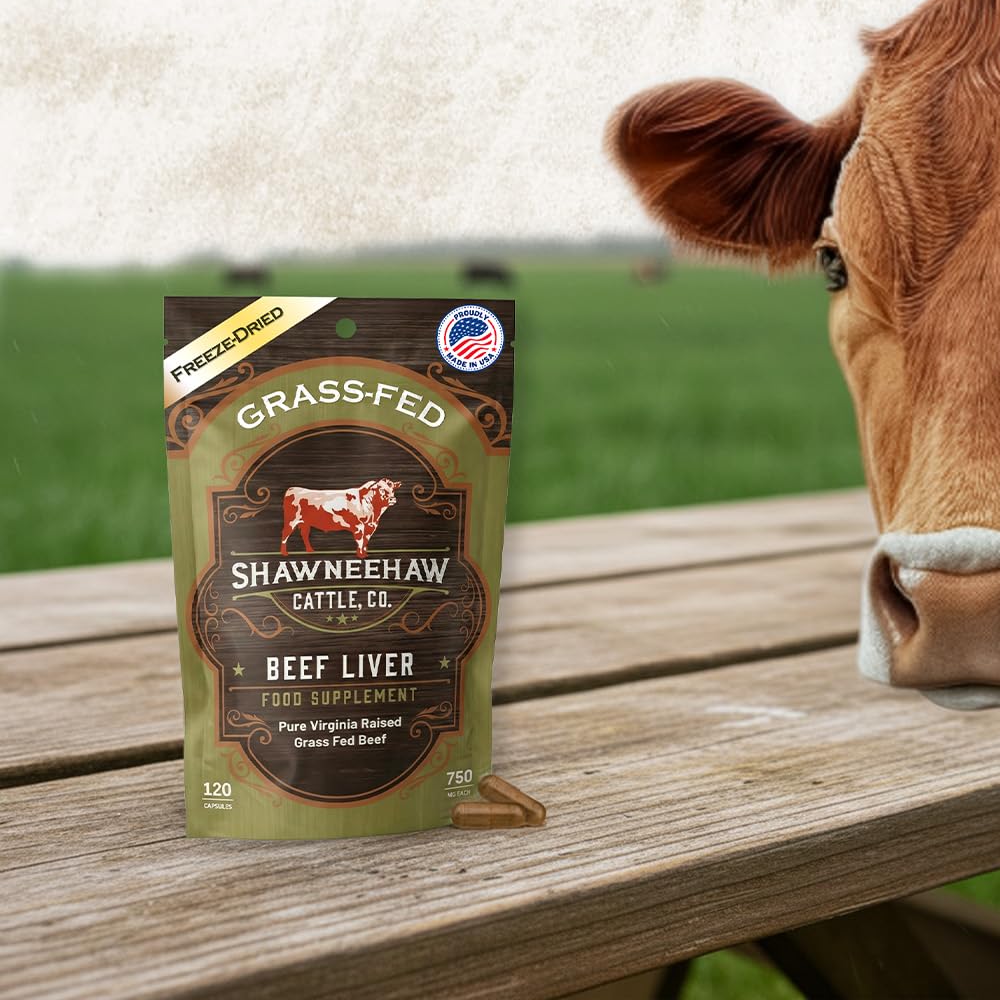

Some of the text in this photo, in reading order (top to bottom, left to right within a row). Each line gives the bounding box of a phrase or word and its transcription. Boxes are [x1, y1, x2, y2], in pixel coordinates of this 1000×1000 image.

[453, 310, 489, 321] PROUDLY
[446, 352, 468, 368] MADE
[478, 353, 495, 366] USA
[237, 379, 446, 429] GRASS-FED
[231, 557, 450, 589] SHAWNEEHAW
[292, 590, 393, 611] CATTLE, CO.
[266, 652, 414, 681] BEEF LIVER
[261, 687, 417, 707] FOOD SUPPLEMENT
[278, 716, 402, 733] Pure Virginia Raised
[294, 733, 387, 748] Grass Fed Beef
[446, 769, 473, 786] 750
[203, 782, 232, 797] 120
